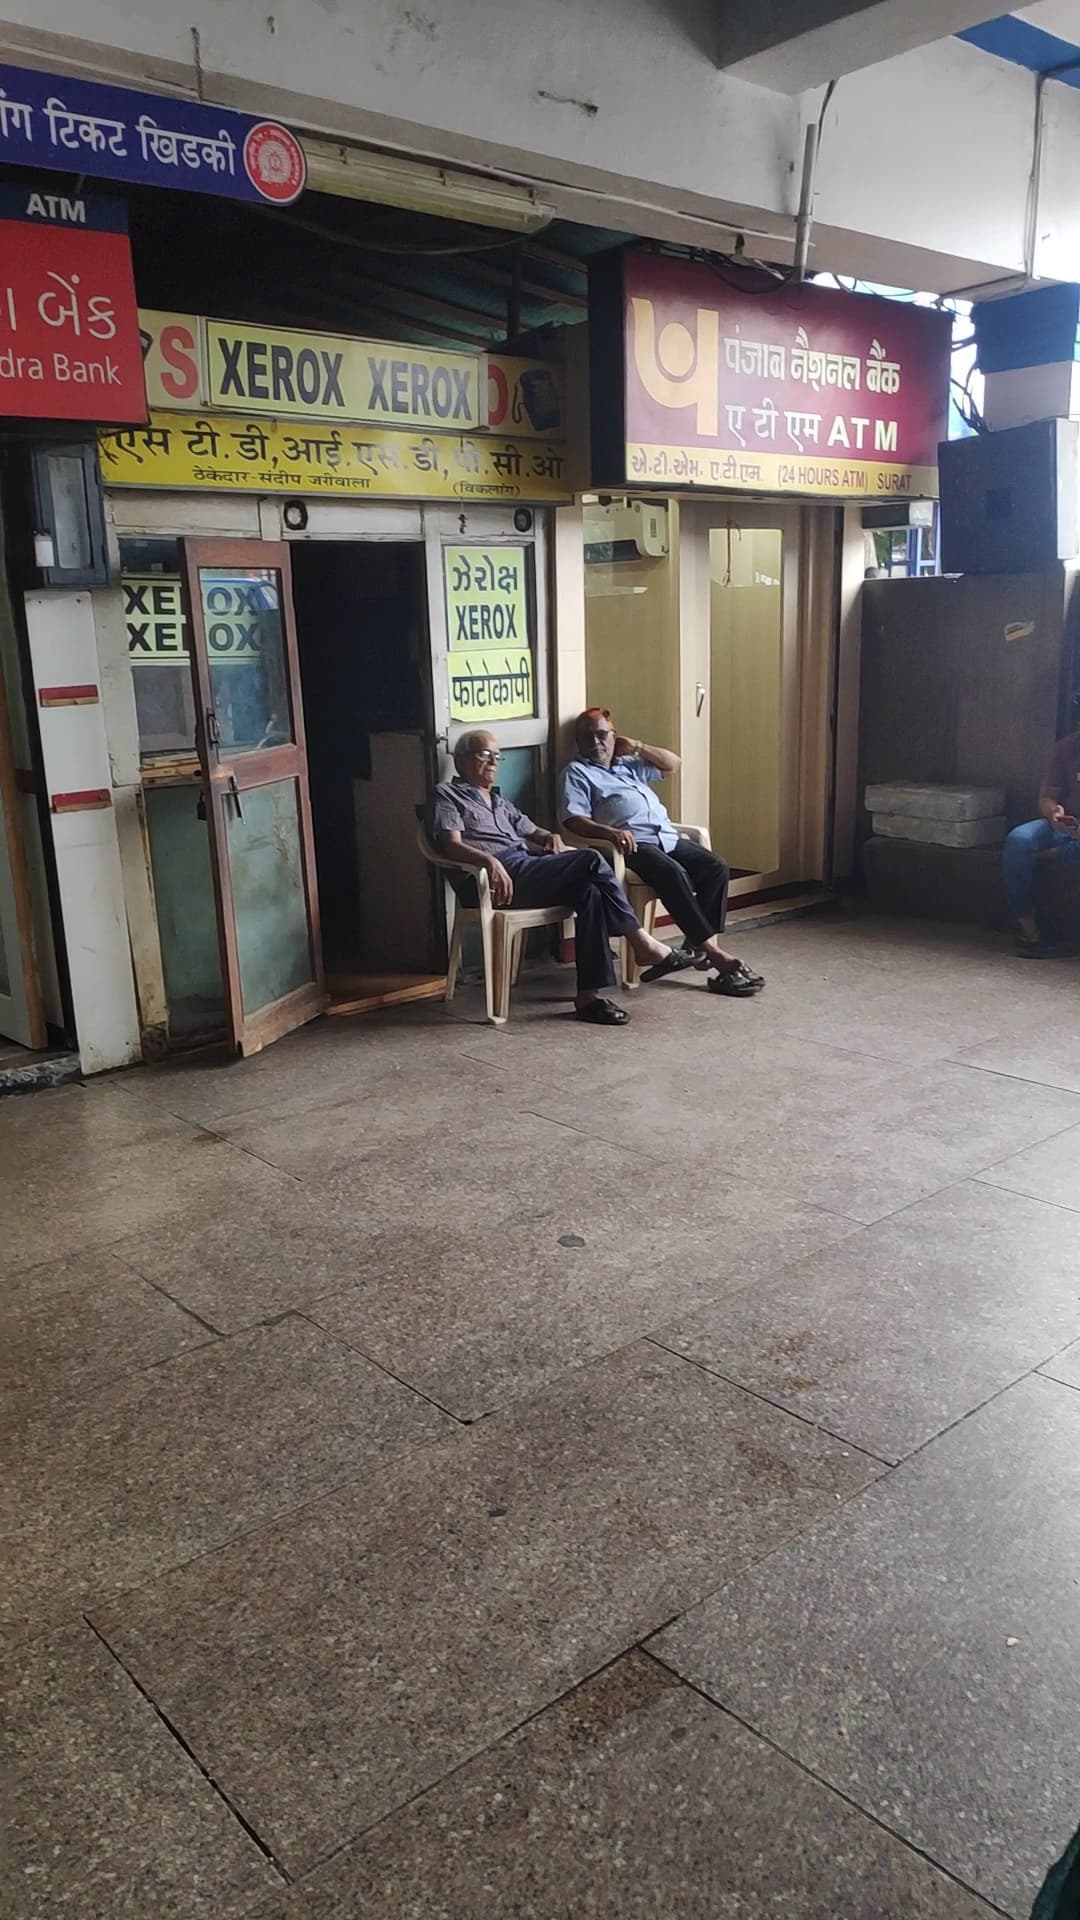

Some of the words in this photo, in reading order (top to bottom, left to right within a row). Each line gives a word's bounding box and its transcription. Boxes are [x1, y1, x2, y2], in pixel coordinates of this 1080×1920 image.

[42, 97, 128, 156] टिकट
[136, 115, 236, 176] खिडकी
[26, 193, 86, 223] ATM
[38, 271, 117, 340] બેંક
[53, 353, 123, 385] Bank
[218, 337, 345, 407] XEROX
[367, 357, 473, 421] XEROX
[724, 325, 785, 380] पंजाब
[866, 338, 900, 394] बैंक
[724, 405, 746, 447] ए
[752, 397, 779, 440] टी
[784, 410, 822, 452] एम
[827, 415, 898, 451] ATM
[798, 467, 840, 486] HOURS
[841, 470, 869, 492] ATM)
[877, 472, 912, 491] SURAT
[452, 555, 518, 594] ઝેરોક્ષ
[121, 585, 258, 616] XEOX
[126, 622, 259, 651] XEOX
[455, 604, 517, 640] XEROX
[452, 656, 530, 708] फोटोकोपी
